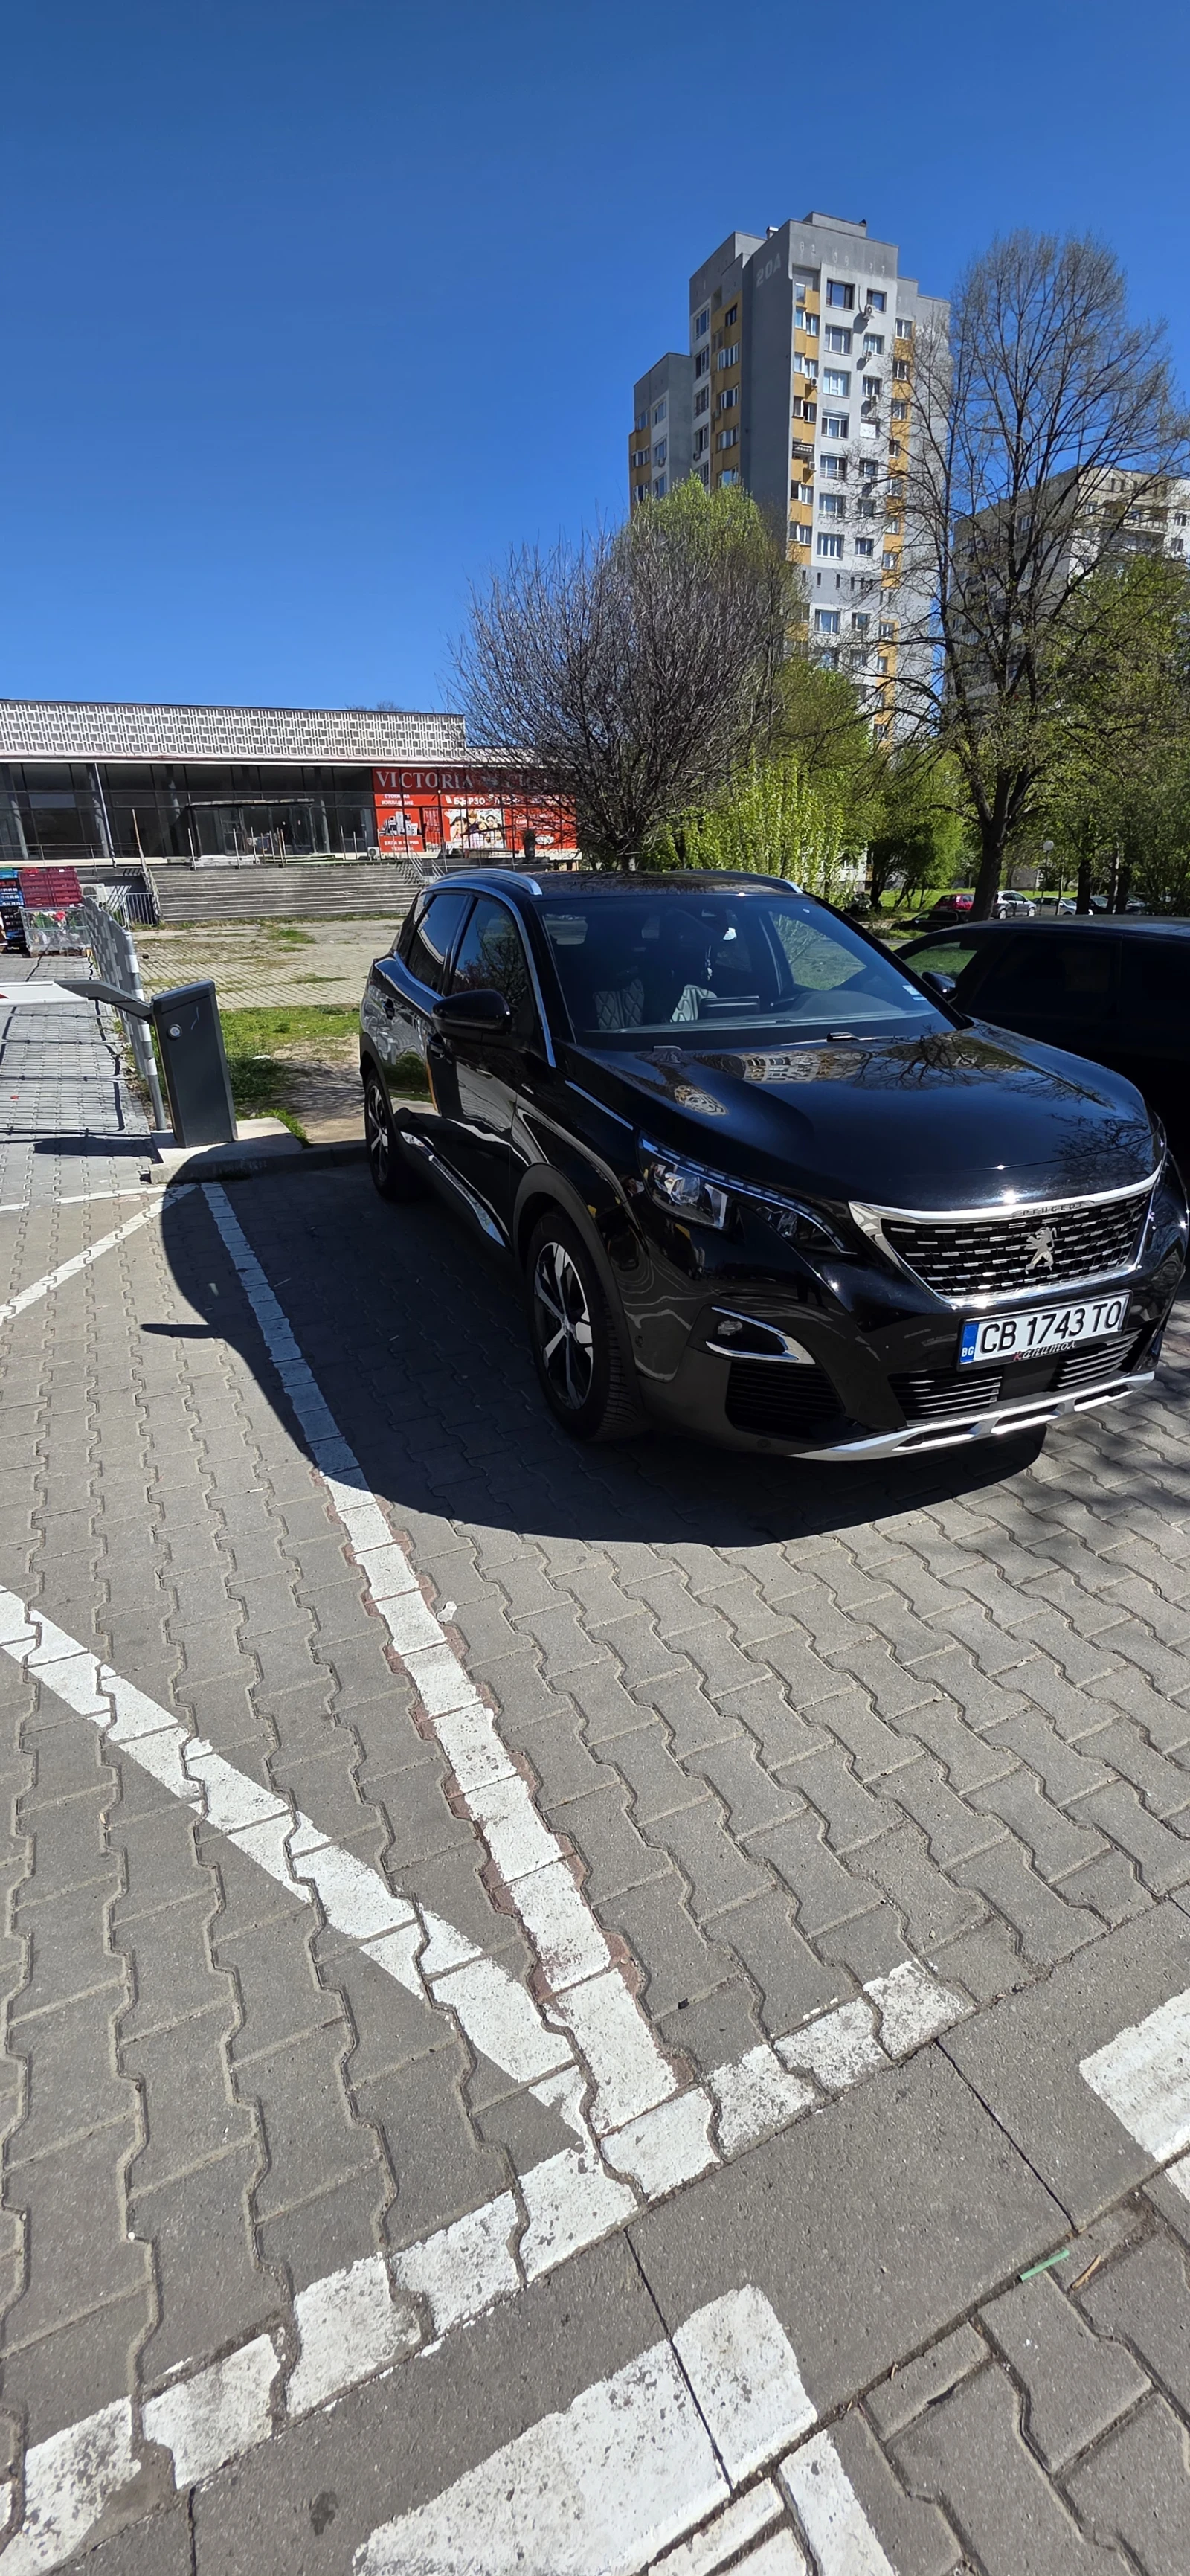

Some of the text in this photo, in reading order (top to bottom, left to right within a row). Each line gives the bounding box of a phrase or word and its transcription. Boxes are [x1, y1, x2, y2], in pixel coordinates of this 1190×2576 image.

[376, 771, 474, 789] VICTORIA
[980, 1300, 1122, 1354] CB 1743 TO
[962, 1346, 974, 1358] BG
